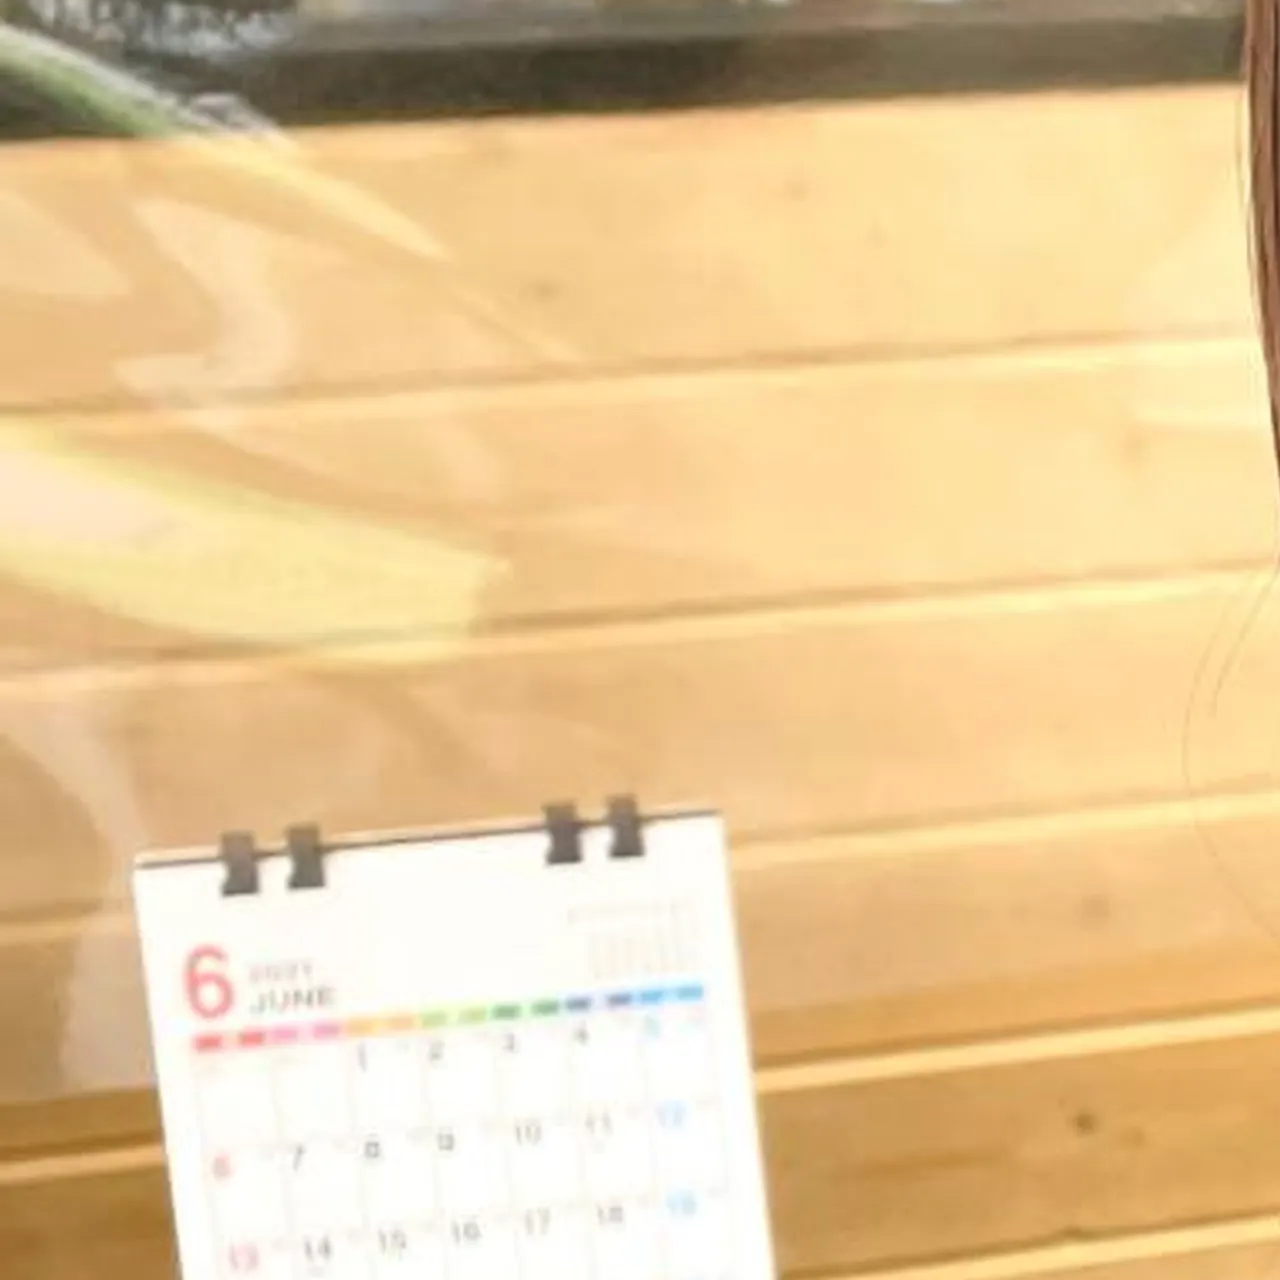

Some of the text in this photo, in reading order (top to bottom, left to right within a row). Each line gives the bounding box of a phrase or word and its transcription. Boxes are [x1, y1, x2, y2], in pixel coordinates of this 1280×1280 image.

[183, 943, 236, 1020] 6
[249, 985, 336, 1015] JUNE
[363, 1136, 383, 1161] 8
[435, 1128, 457, 1154] 9
[514, 1118, 542, 1145] 10
[584, 1109, 614, 1138] 11
[303, 1235, 334, 1266] 14
[378, 1226, 407, 1257] 15
[450, 1217, 483, 1245] 16
[524, 1206, 552, 1235] 17
[596, 1204, 625, 1227] 18
